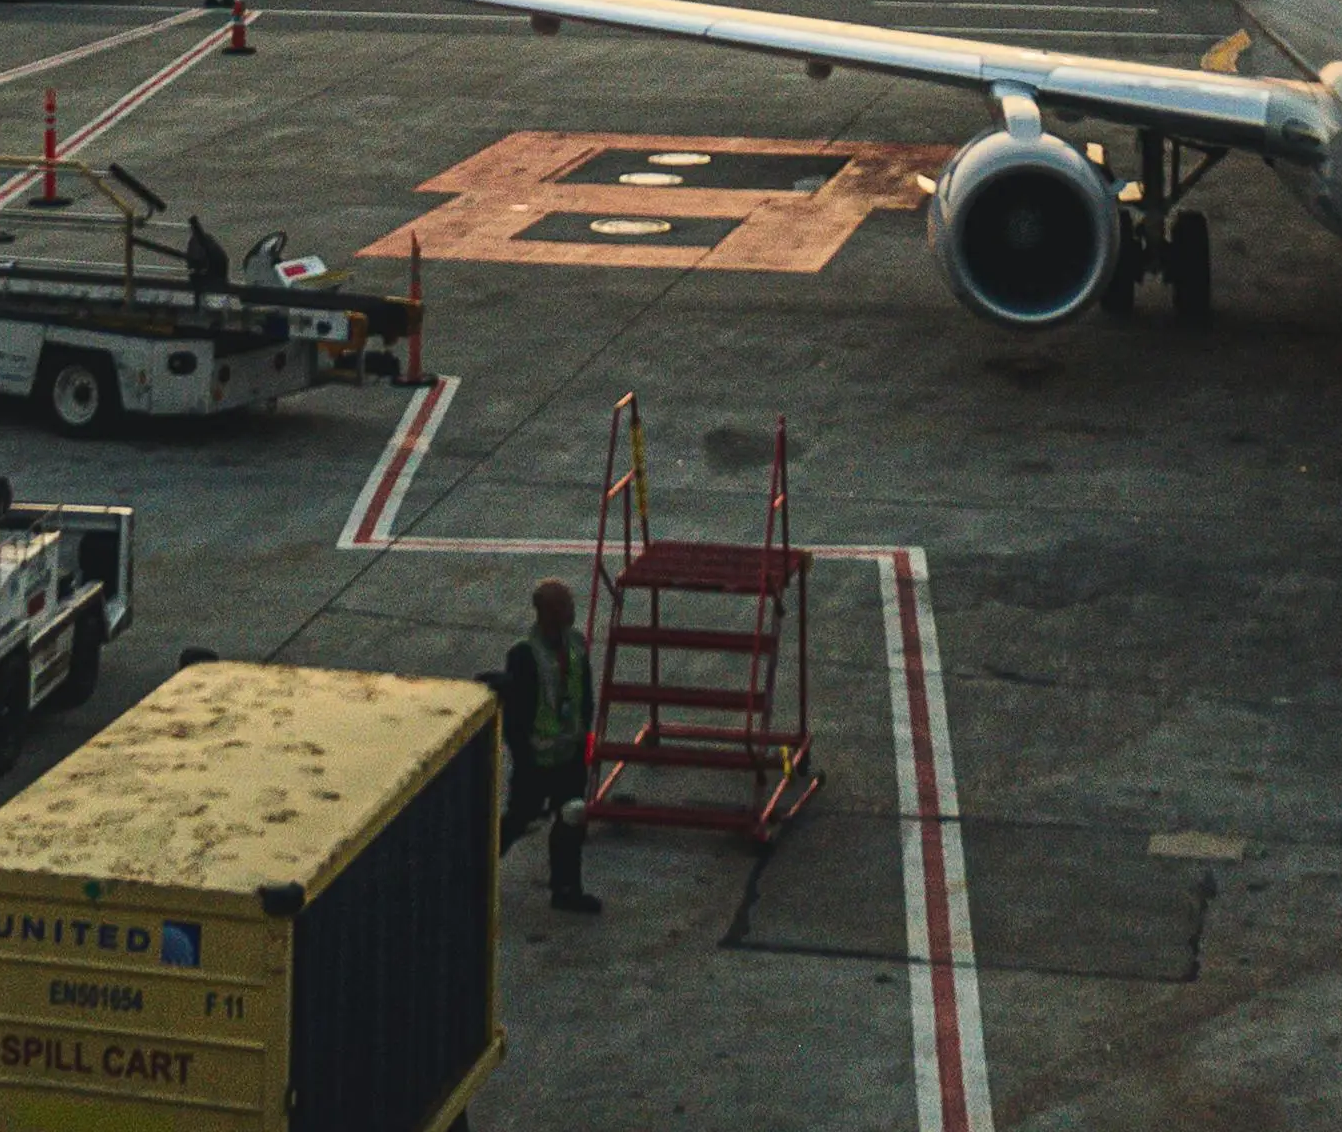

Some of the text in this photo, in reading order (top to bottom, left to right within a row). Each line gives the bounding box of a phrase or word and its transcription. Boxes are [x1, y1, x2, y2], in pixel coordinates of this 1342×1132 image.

[205, 990, 217, 1016] F
[226, 993, 244, 1018] 11
[0, 1033, 194, 1085] SPILL CART
